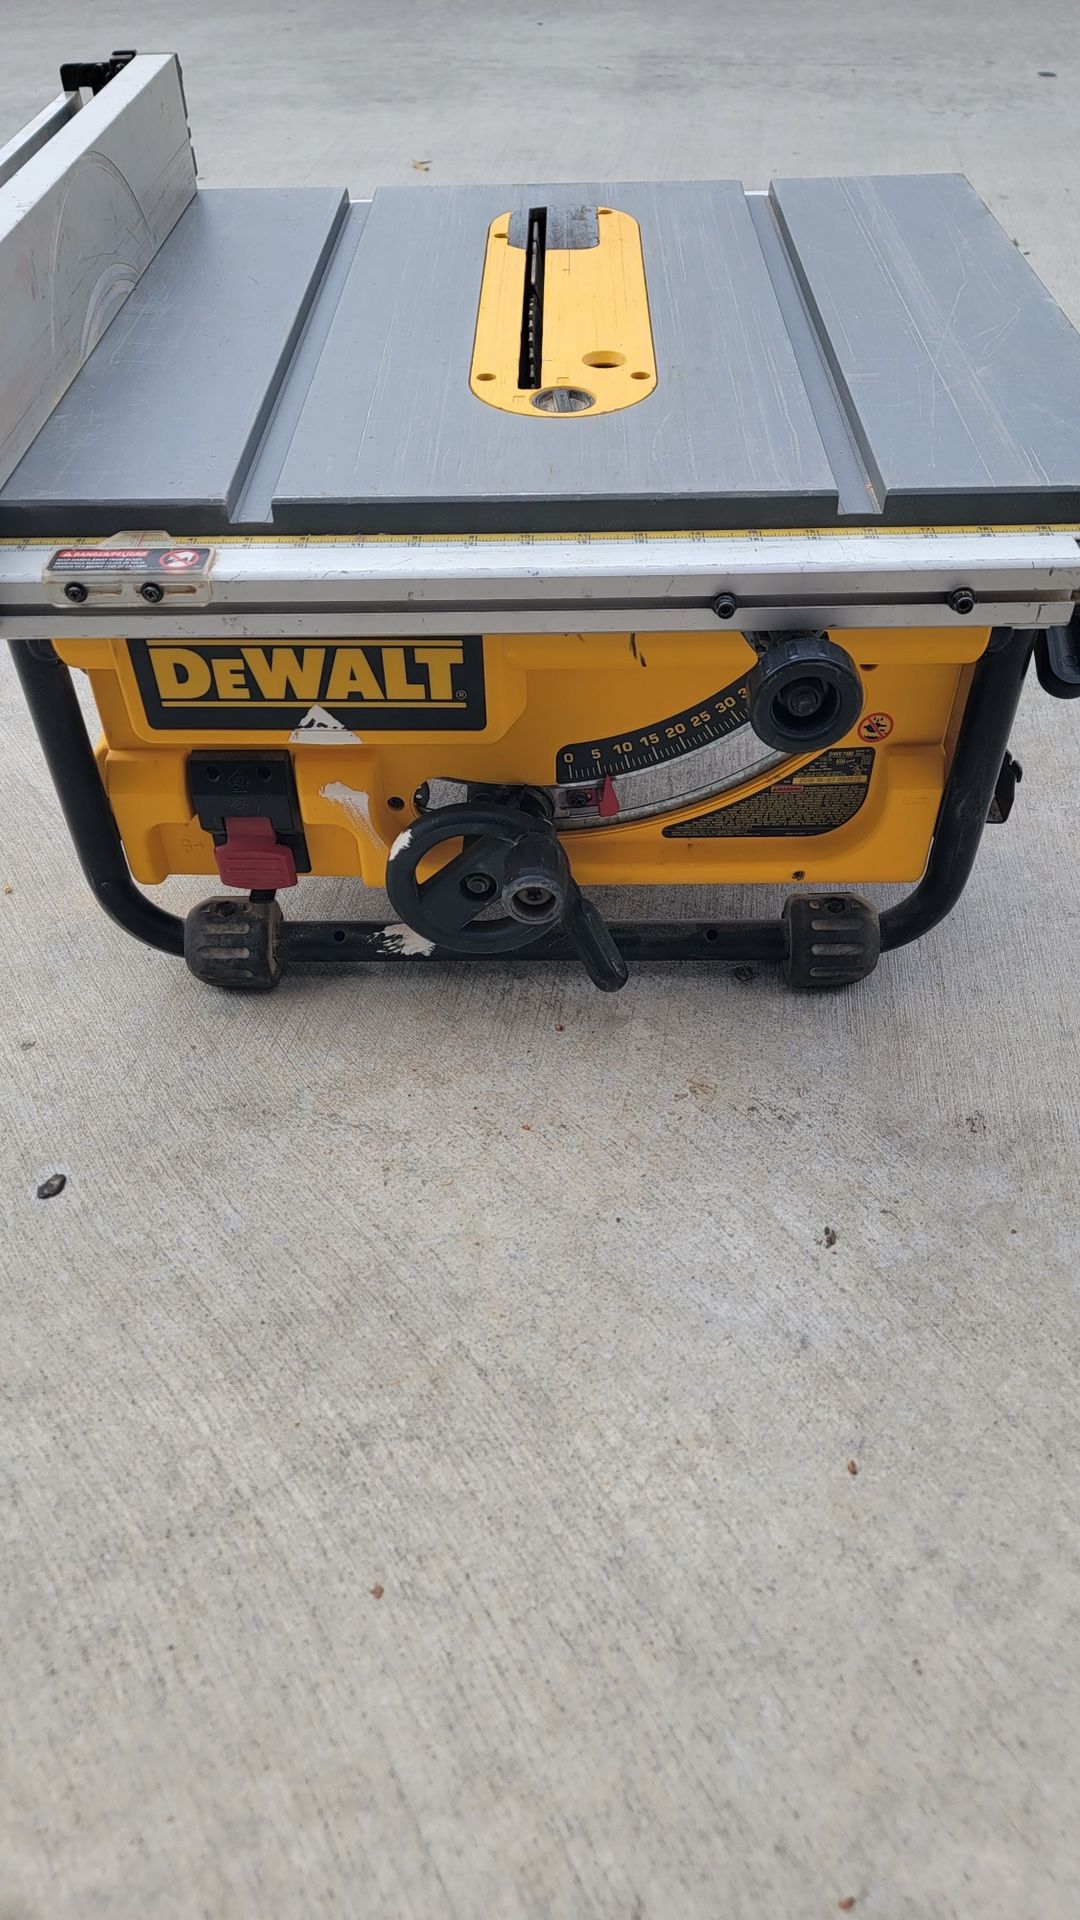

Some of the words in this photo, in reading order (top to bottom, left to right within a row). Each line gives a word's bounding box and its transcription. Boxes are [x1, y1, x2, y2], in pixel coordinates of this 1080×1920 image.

[563, 752, 574, 764] 0
[591, 748, 602, 759] 5
[613, 741, 633, 755] 10
[639, 732, 660, 747] 15
[665, 722, 686, 739] 20
[690, 710, 712, 728] 25
[714, 696, 736, 714] 30
